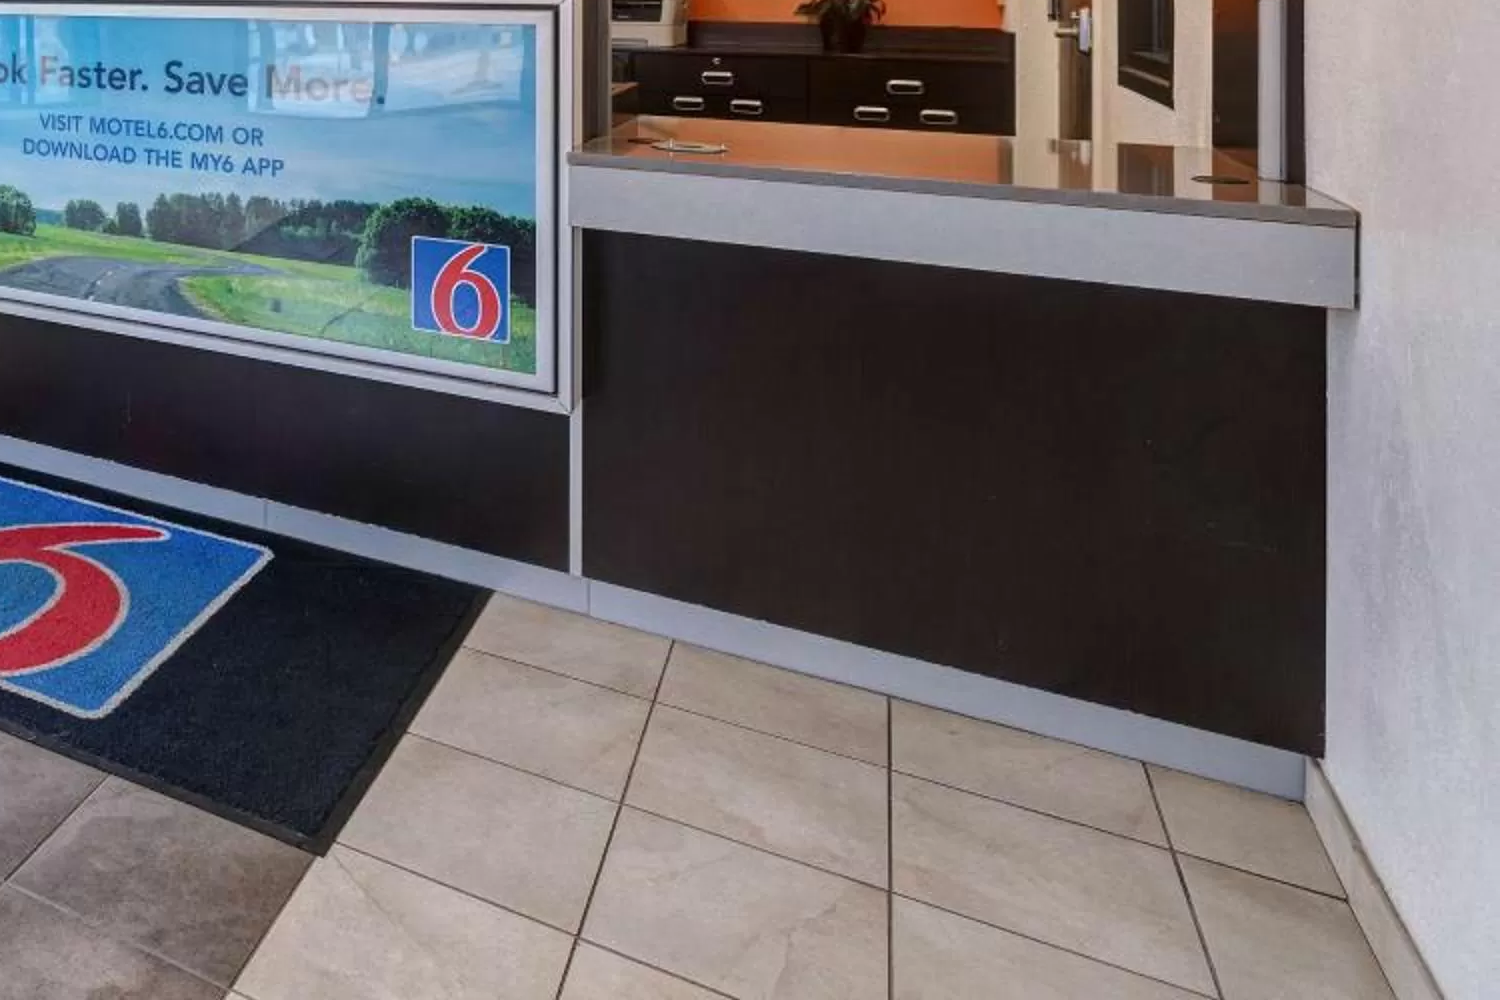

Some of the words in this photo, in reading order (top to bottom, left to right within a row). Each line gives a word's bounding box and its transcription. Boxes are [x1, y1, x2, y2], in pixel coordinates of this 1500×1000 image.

[39, 54, 149, 92] Faster.
[164, 59, 249, 98] Save
[265, 63, 385, 104] More.
[39, 112, 83, 133] VISIT
[89, 116, 224, 145] MOTEL6.COM
[232, 126, 264, 147] OR
[22, 137, 137, 165] DOWNLOAD
[143, 148, 183, 169] THE
[190, 151, 234, 174] MY6
[241, 157, 284, 177] APP
[430, 243, 502, 340] 6
